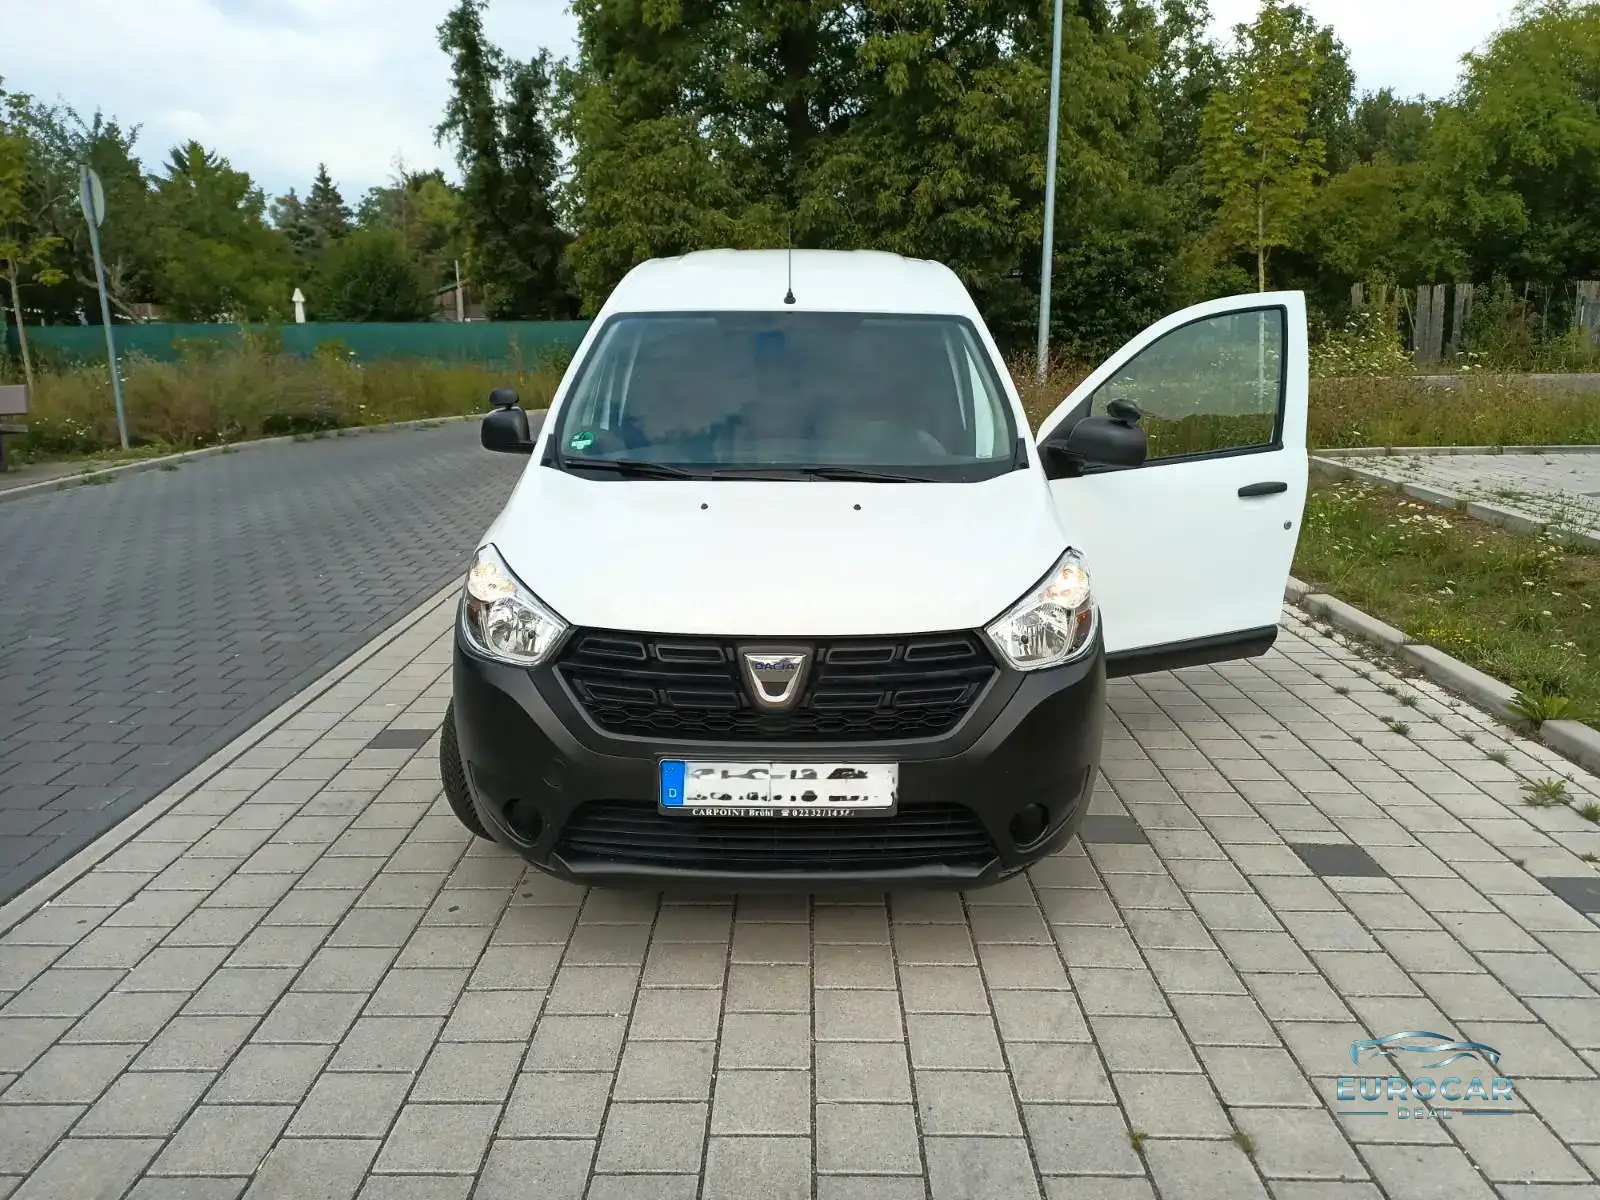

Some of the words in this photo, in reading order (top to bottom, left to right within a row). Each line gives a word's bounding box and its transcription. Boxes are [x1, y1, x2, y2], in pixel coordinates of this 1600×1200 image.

[755, 663, 795, 671] DACIA
[668, 789, 677, 798] D
[692, 808, 743, 817] CARPOINT
